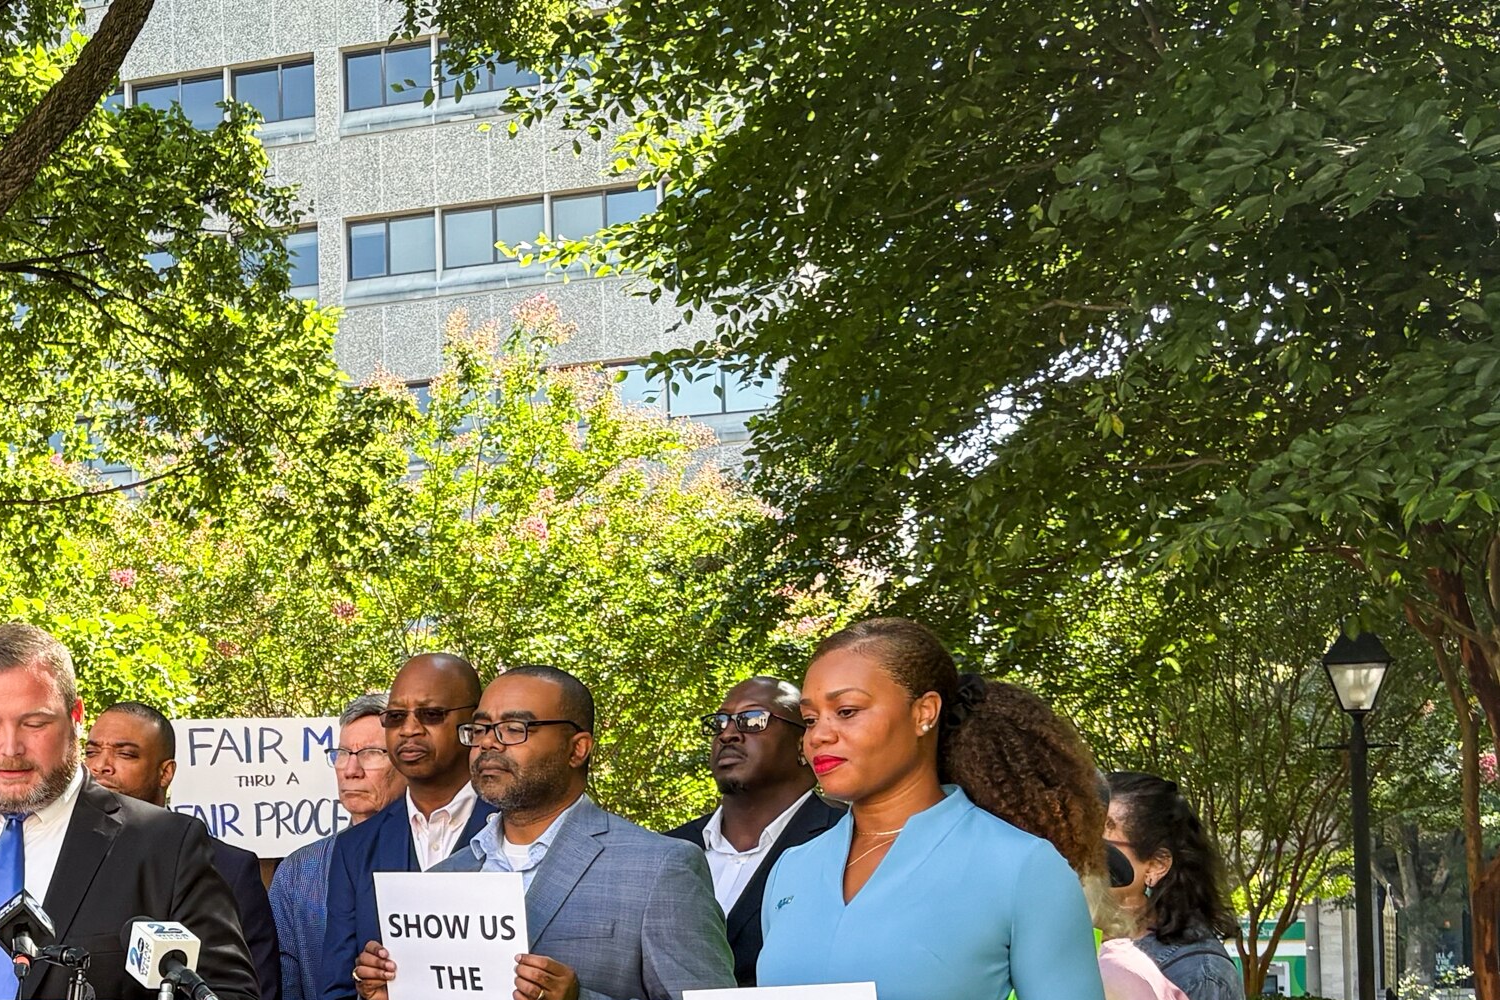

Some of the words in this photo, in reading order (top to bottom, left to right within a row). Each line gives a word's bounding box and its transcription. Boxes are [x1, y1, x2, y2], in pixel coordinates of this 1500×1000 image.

[188, 726, 289, 767] FAIR
[235, 774, 276, 788] THRU
[286, 771, 300, 785] A
[388, 913, 470, 940] SHOW
[479, 915, 516, 941] US
[429, 965, 484, 992] THE
